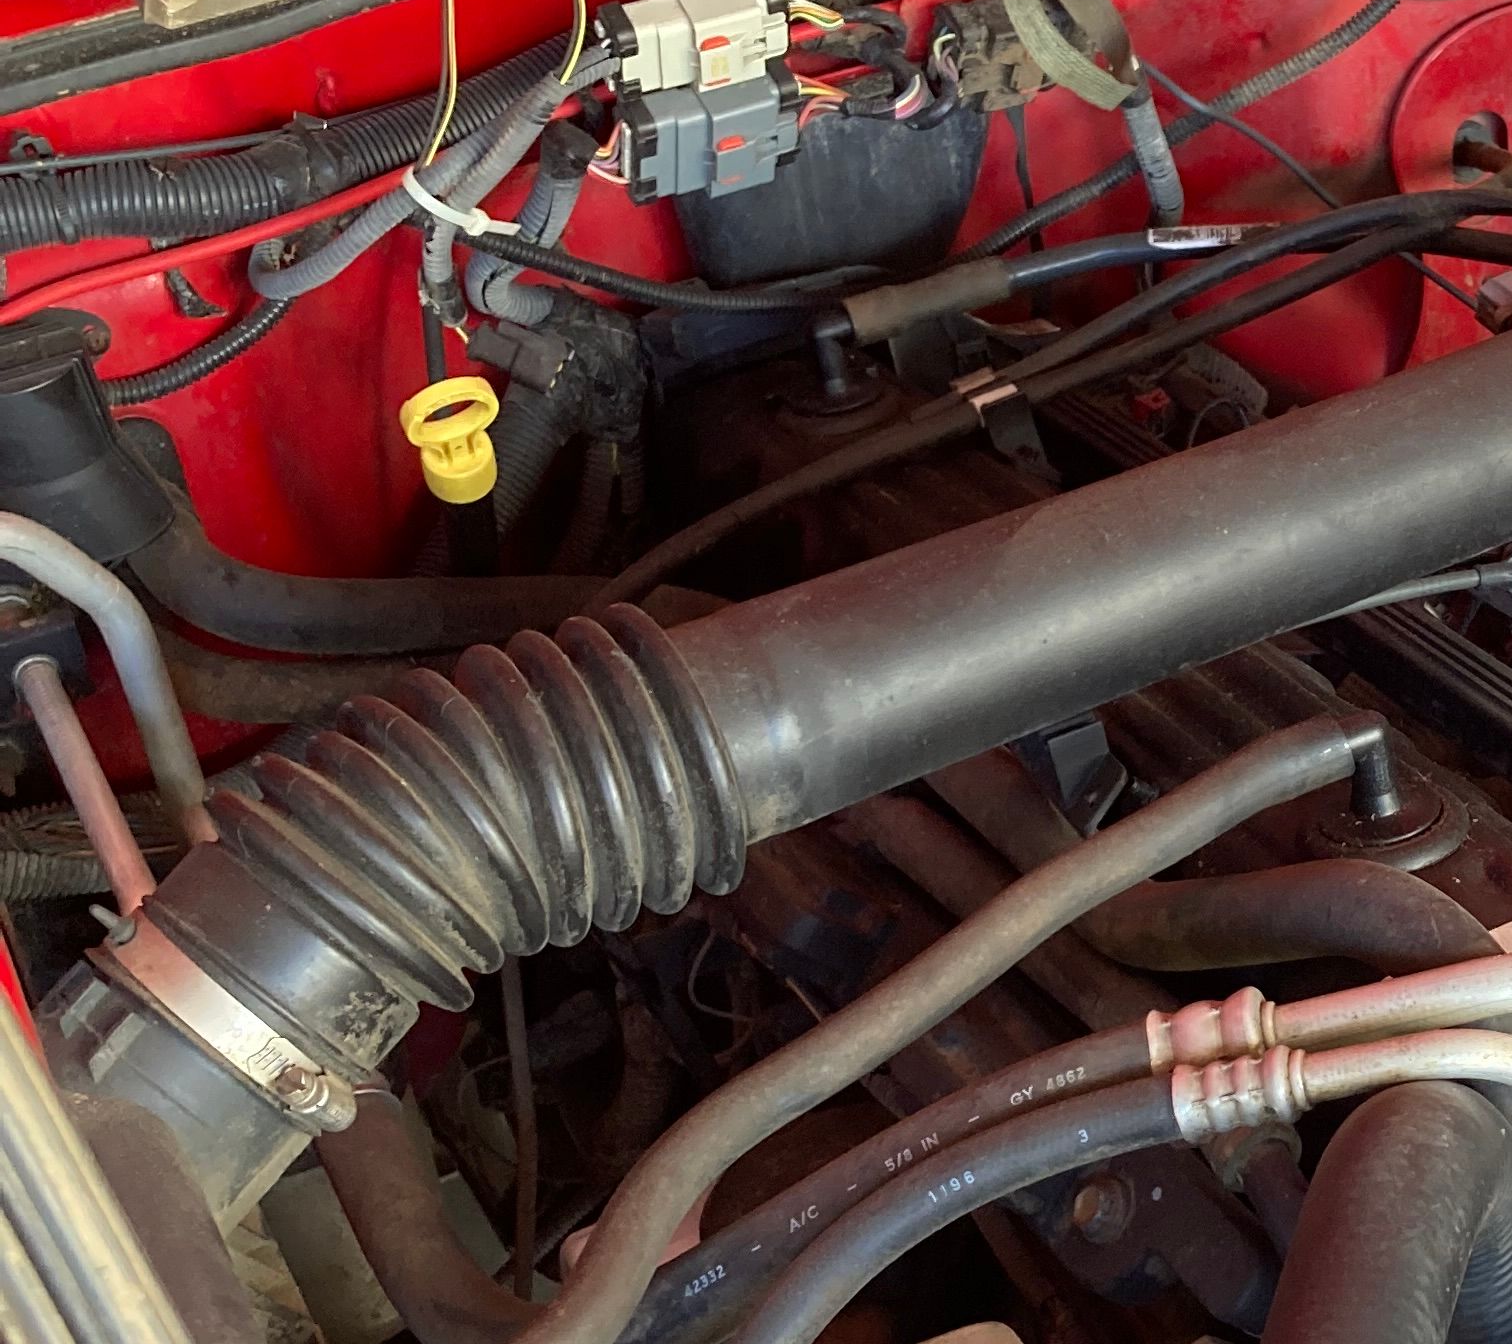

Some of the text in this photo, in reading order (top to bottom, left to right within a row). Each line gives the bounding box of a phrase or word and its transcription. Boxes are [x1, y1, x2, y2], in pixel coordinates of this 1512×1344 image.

[788, 1204, 821, 1234] A/C
[884, 1147, 914, 1173] 5/8
[920, 1132, 940, 1152] IN
[1010, 1085, 1034, 1107] GY
[1078, 1128, 1089, 1144] 3
